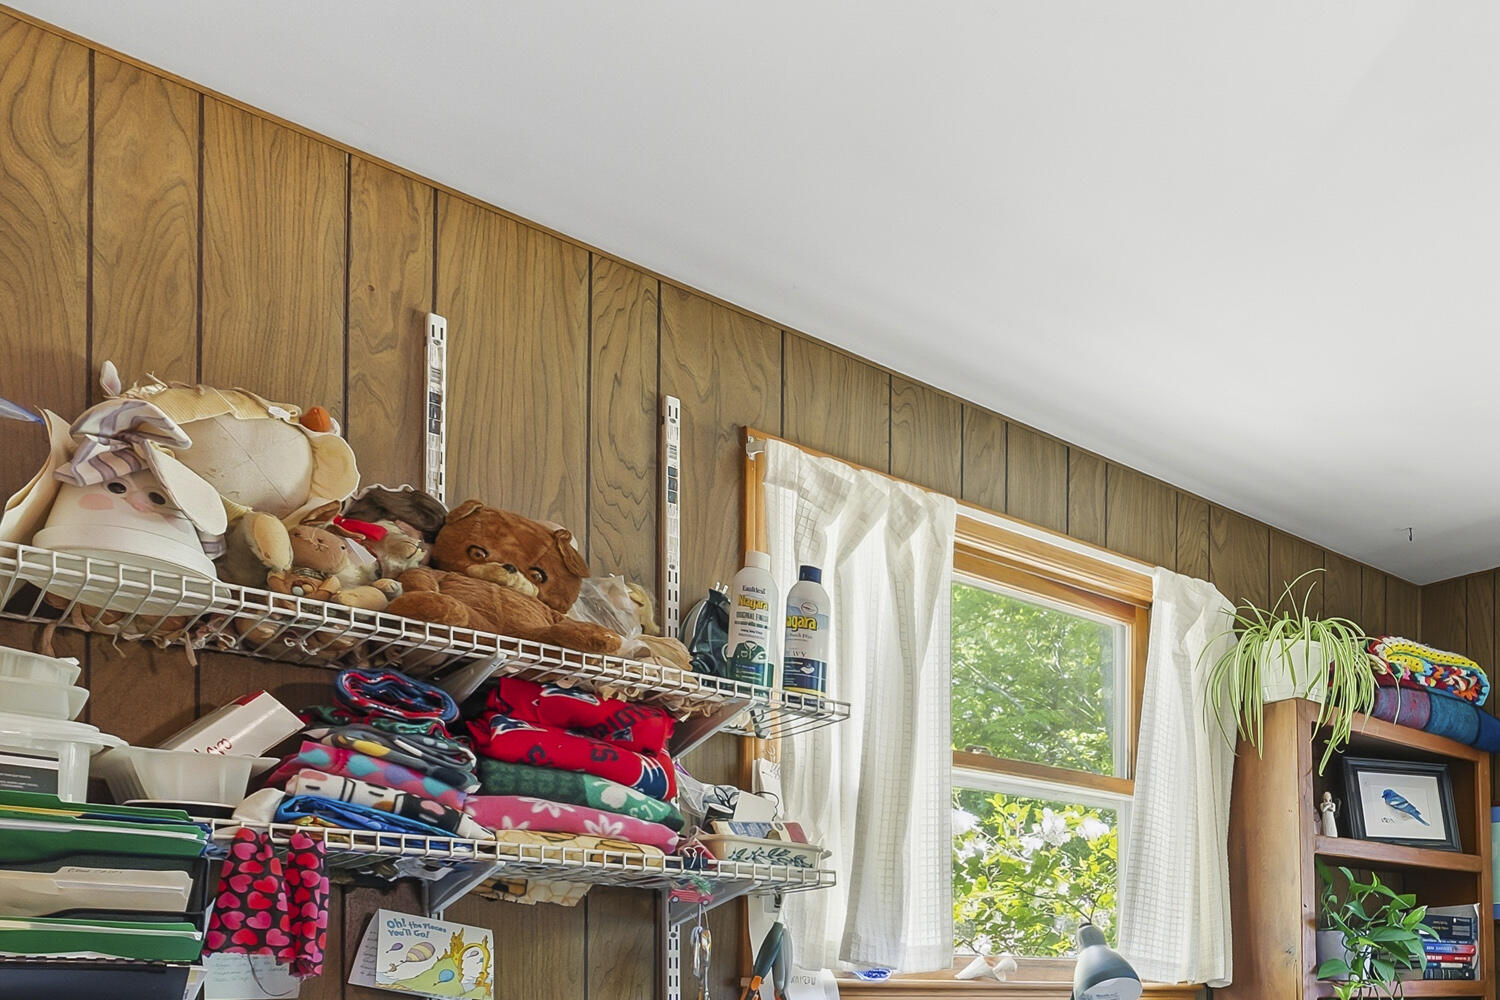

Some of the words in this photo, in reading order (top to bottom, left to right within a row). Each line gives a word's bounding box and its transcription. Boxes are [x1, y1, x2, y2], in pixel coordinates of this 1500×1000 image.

[738, 594, 769, 611] Niagara
[785, 615, 817, 632] agara
[386, 918, 406, 929] Oh!
[408, 920, 422, 929] the
[388, 929, 412, 937] You'll
[413, 931, 430, 939] Go!
